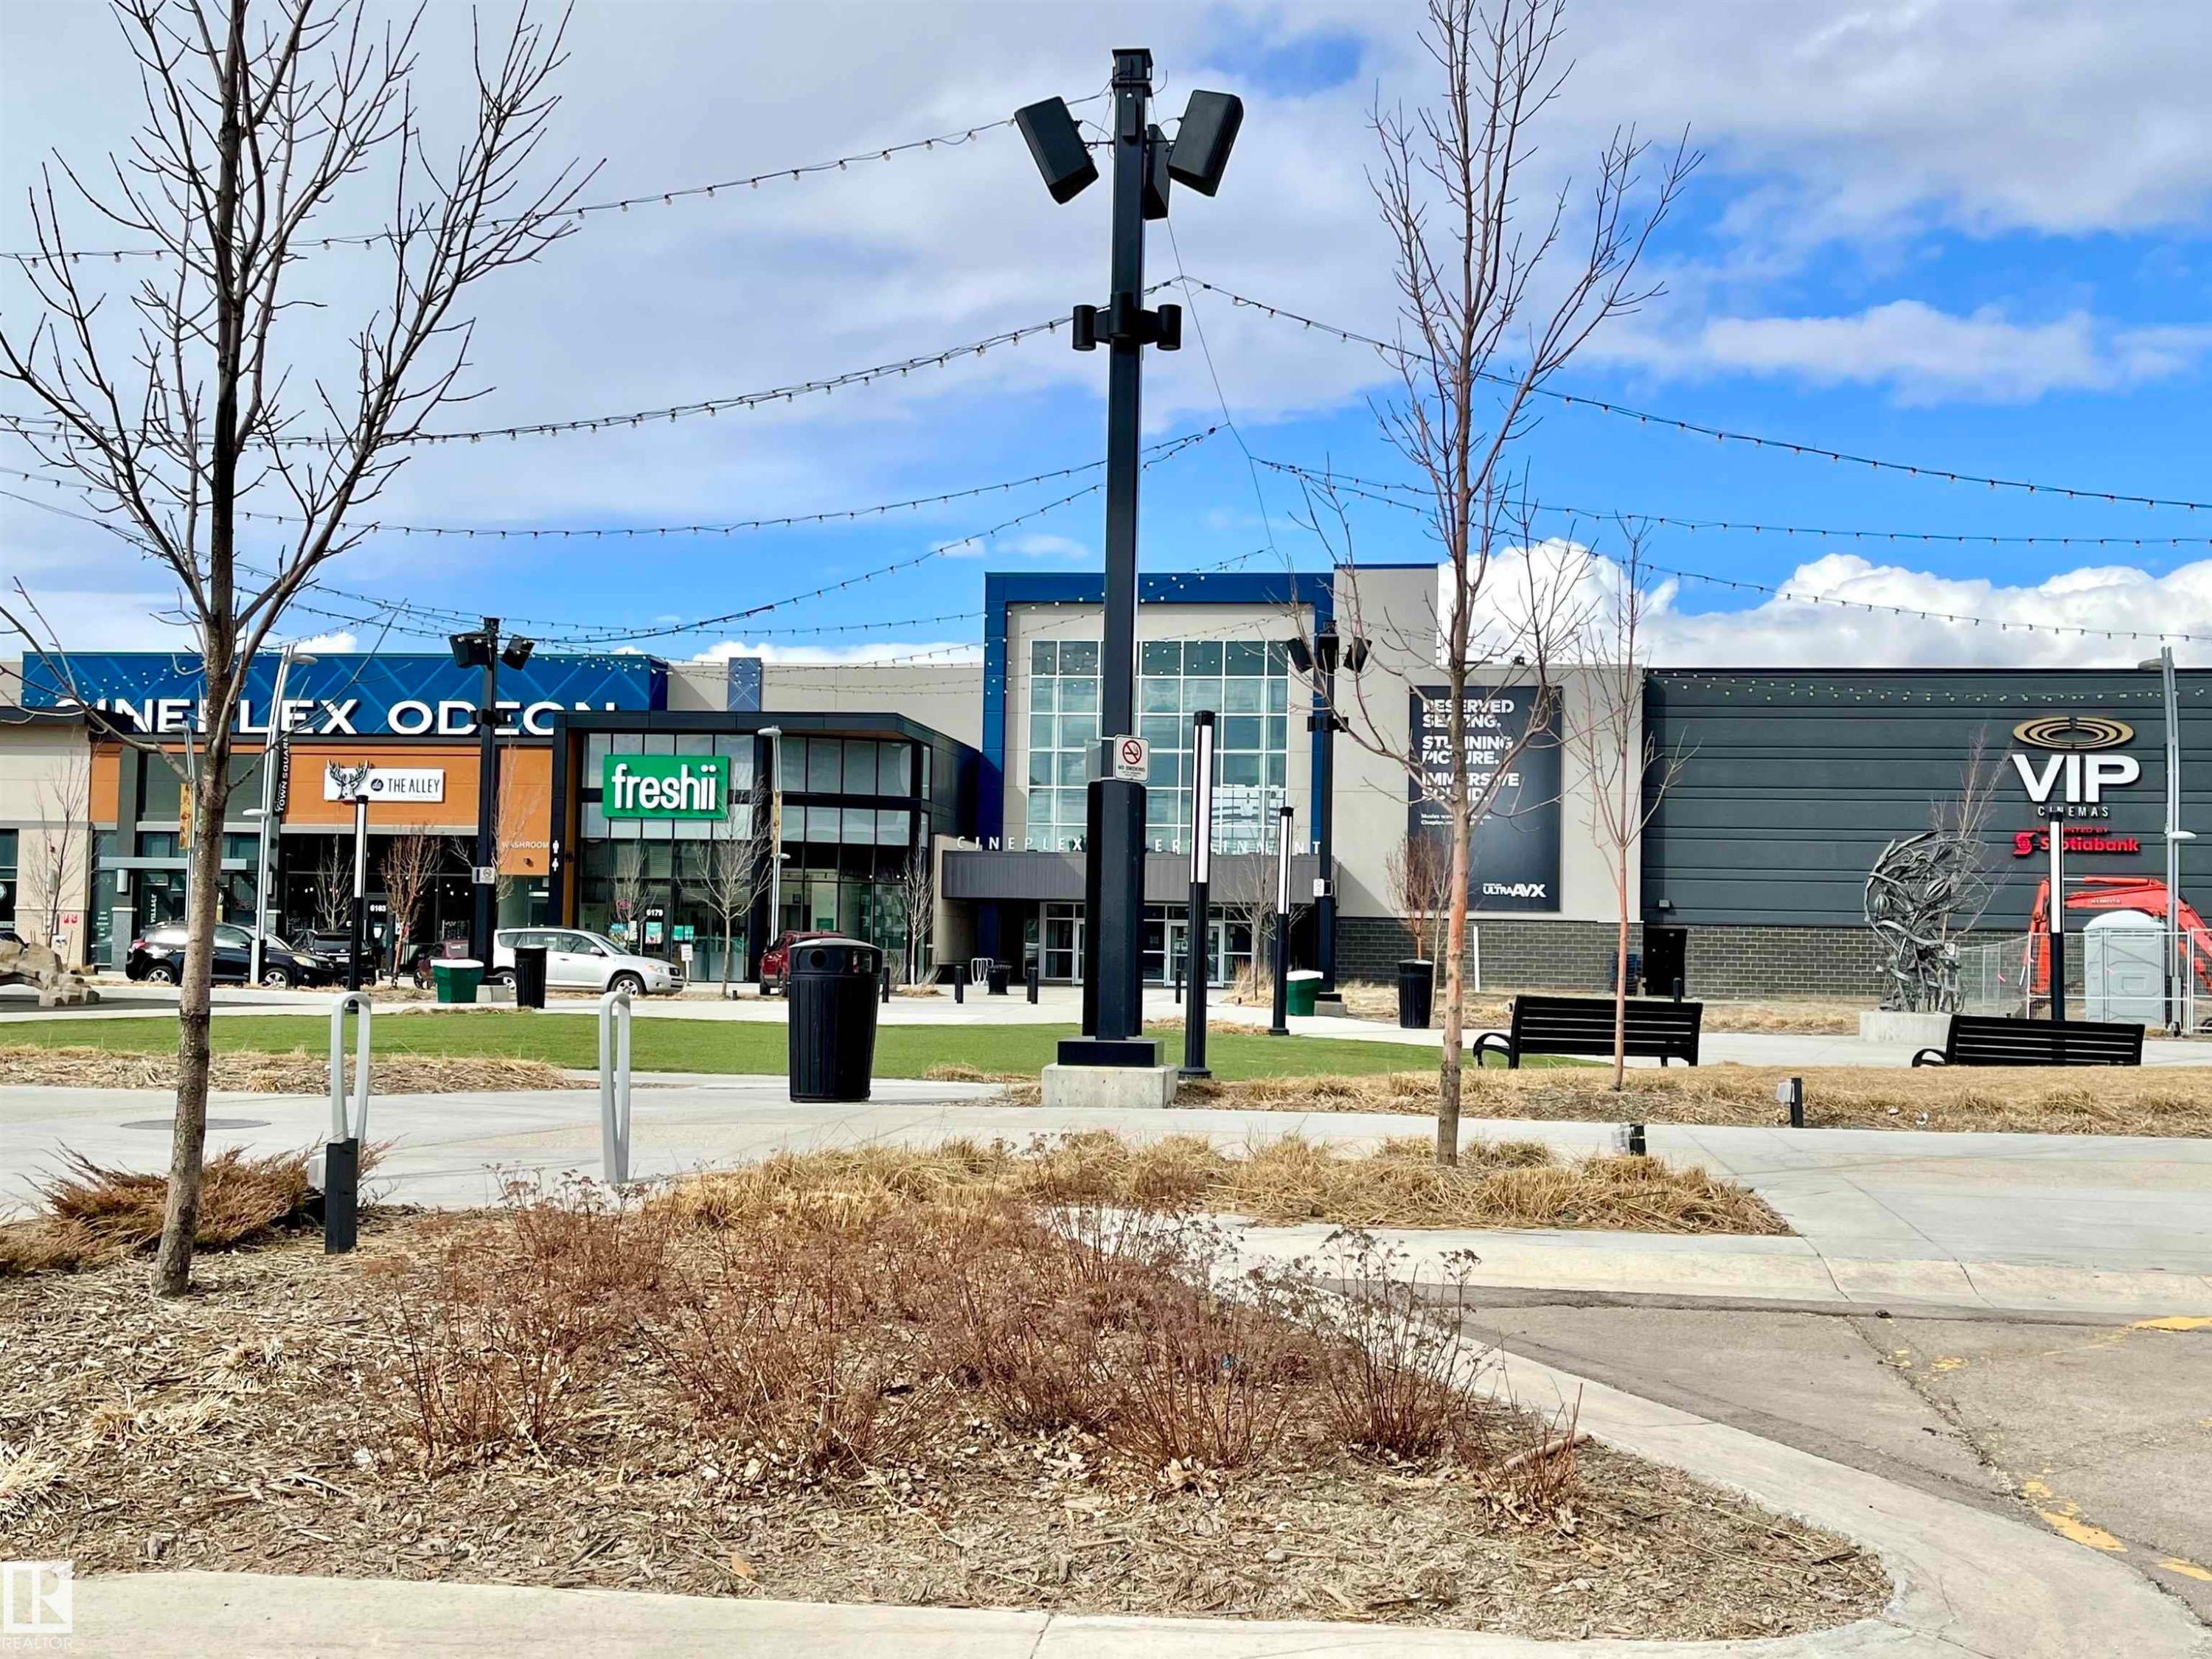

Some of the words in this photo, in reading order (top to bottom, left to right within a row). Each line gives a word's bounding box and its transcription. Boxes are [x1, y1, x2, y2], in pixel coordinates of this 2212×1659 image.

[389, 778, 406, 793] THE
[408, 778, 440, 793] ALLEY
[611, 763, 717, 810] freshii
[2011, 754, 2140, 802] VIP
[278, 781, 288, 811] TOWN
[957, 836, 1082, 851] CINEPLEX
[2040, 836, 2140, 851] Sotiabank
